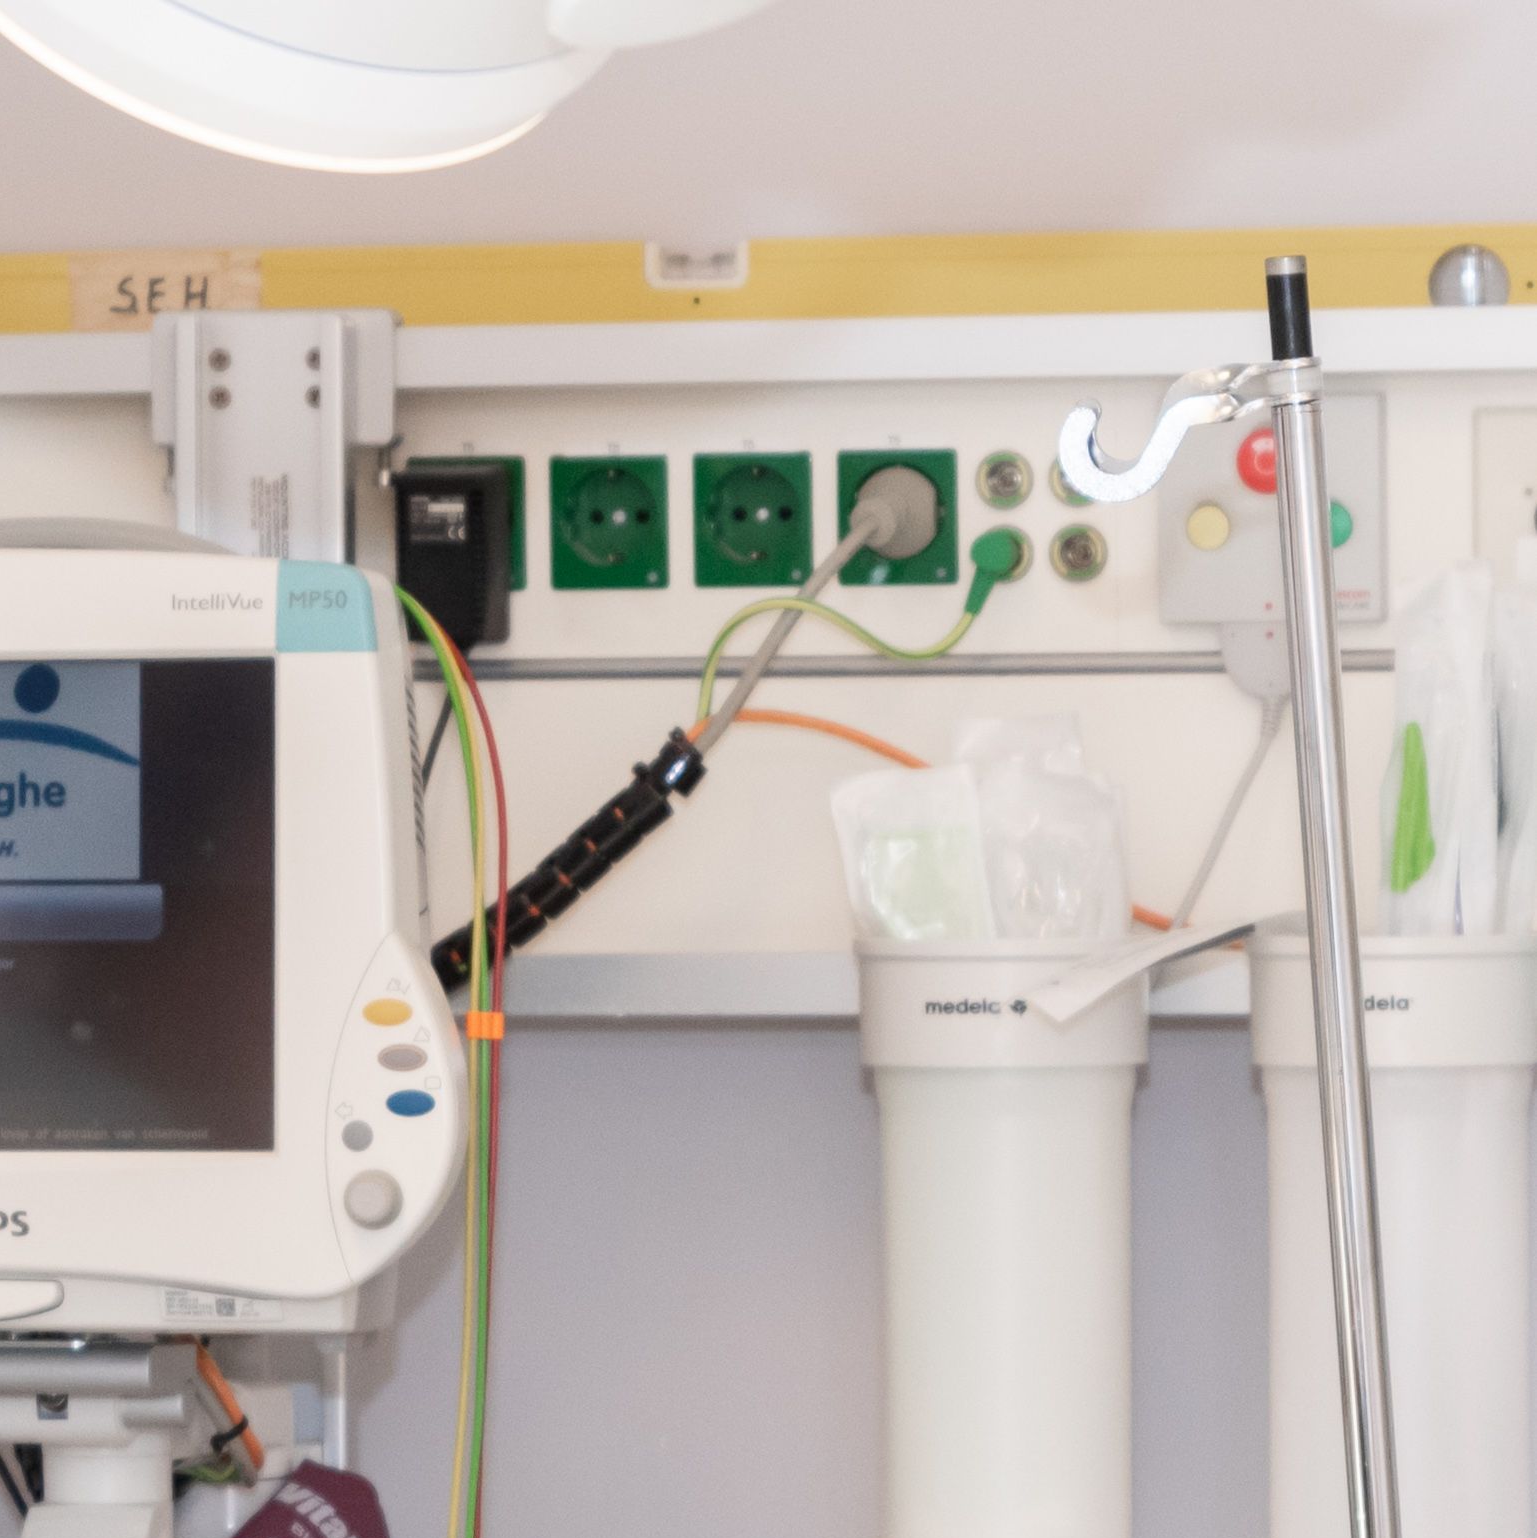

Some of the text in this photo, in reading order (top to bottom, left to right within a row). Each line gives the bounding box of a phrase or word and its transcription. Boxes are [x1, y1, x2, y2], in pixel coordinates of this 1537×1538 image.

[171, 590, 348, 611] IntelliVue MP50
[1364, 995, 1409, 1012] dela
